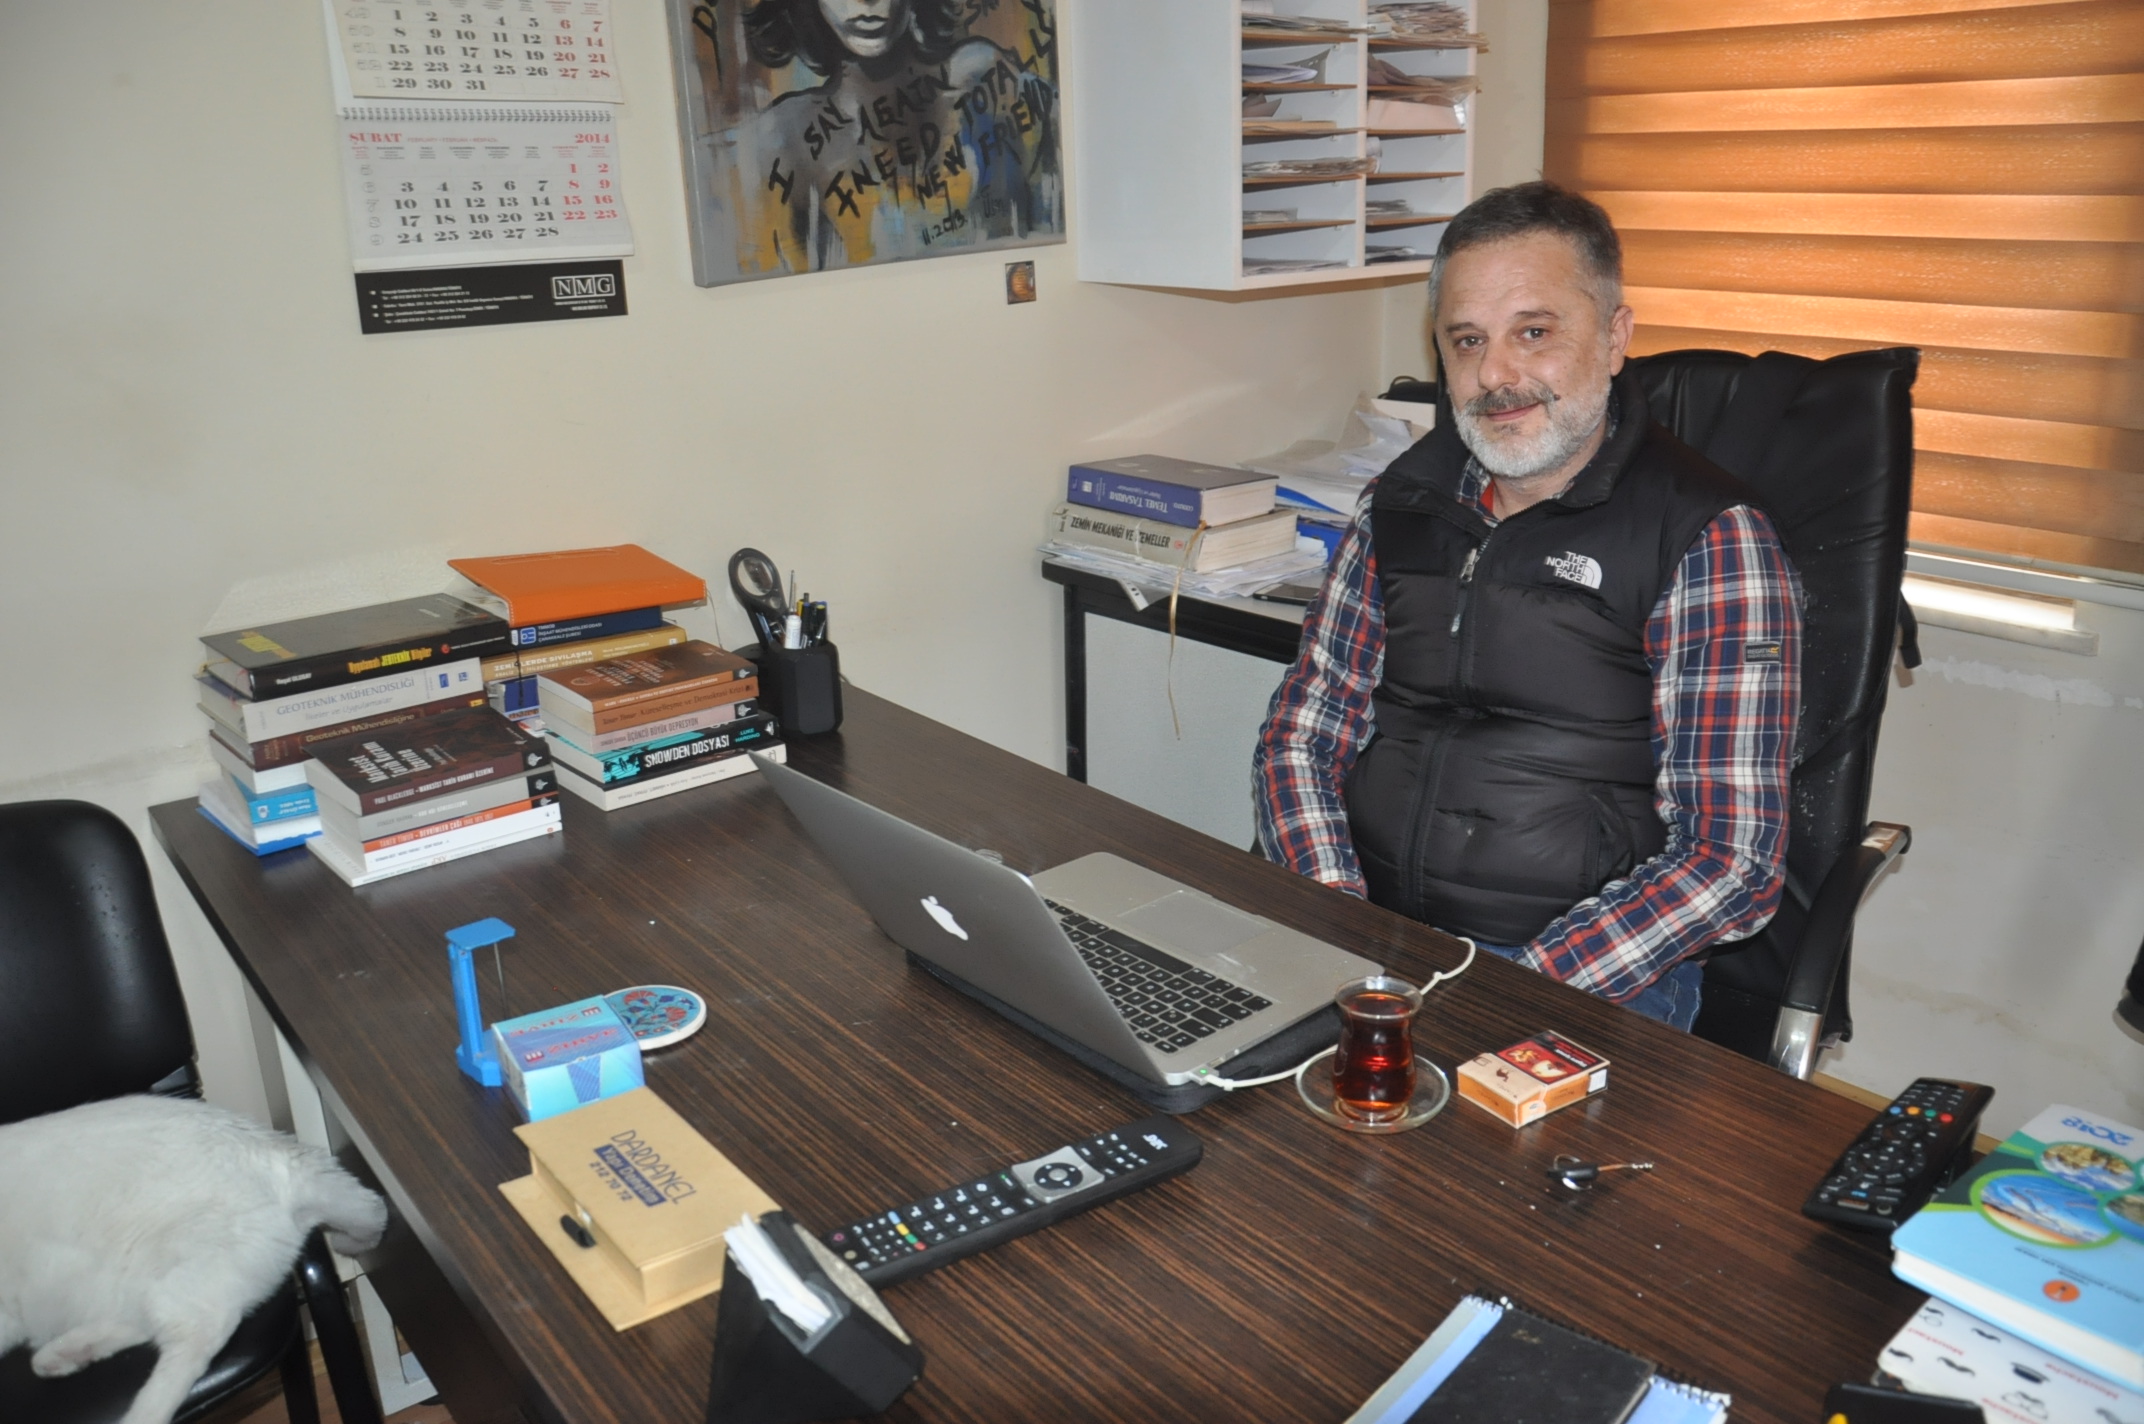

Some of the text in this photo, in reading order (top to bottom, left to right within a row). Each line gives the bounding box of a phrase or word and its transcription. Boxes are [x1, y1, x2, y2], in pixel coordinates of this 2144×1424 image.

[394, 10, 401, 20] 1
[426, 12, 438, 22] 2
[460, 14, 473, 24] 3
[494, 16, 506, 26] 4
[528, 18, 540, 28] 5
[560, 19, 572, 30] 6
[592, 20, 603, 32] 7
[394, 27, 406, 38] 8
[429, 28, 442, 38] 9
[455, 30, 476, 40] 10
[492, 32, 508, 42] 11
[522, 34, 542, 44] 12
[554, 35, 574, 46] 13
[586, 36, 604, 48] 14
[389, 44, 410, 54] 15
[424, 45, 446, 56] 16
[460, 46, 480, 58] 17
[494, 48, 513, 59] 18
[525, 50, 545, 60] 19
[554, 52, 576, 62] 20
[588, 53, 606, 64] 21
[388, 60, 414, 71] 22
[424, 62, 450, 72] 23
[460, 62, 483, 74] 24
[494, 64, 516, 75] 25
[525, 66, 549, 76] 26
[558, 68, 580, 78] 27
[588, 69, 610, 78] 28
[392, 78, 417, 88] 29
[427, 78, 452, 90] 30
[466, 80, 486, 90] 31
[574, 133, 610, 144] 2014
[570, 164, 577, 174] 1
[598, 163, 608, 173] 2
[401, 182, 414, 192] 3
[436, 182, 448, 192] 4
[472, 181, 483, 191] 5
[504, 181, 516, 190] 6
[538, 180, 548, 192] 7
[569, 180, 580, 189] 8
[600, 180, 610, 188] 9
[395, 199, 418, 210] 10
[434, 198, 451, 208] 11
[464, 198, 486, 208] 12
[498, 197, 519, 207] 13
[531, 196, 550, 206] 14
[563, 196, 582, 205] 15
[594, 195, 614, 204] 16
[400, 215, 421, 227] 17
[435, 214, 456, 224] 18
[469, 214, 490, 224] 19
[497, 213, 522, 223] 20
[534, 212, 554, 222] 21
[562, 210, 586, 220] 22
[594, 210, 617, 220] 23
[397, 232, 423, 244] 24
[434, 231, 460, 242] 25
[468, 230, 494, 240] 26
[503, 228, 526, 239] 27
[535, 227, 559, 236] 28
[556, 276, 612, 297] NMG
[1142, 499, 1169, 514] TEMEL
[1071, 515, 1091, 533] ZEMİN
[1125, 529, 1134, 540] VE
[1545, 556, 1585, 574] NORTH
[1565, 551, 1588, 566] THE
[1555, 567, 1582, 584] FACE
[494, 656, 548, 672] ZEMİLERDE
[550, 650, 593, 662] SIVILAŞMA
[276, 676, 415, 716] GEOTEKNİK MÜHENDİSLİĞİ
[650, 722, 668, 738] BÜYÜK
[668, 715, 699, 736] DEPRESYON
[645, 740, 691, 769] SNOWDEN
[692, 734, 730, 759] DOSYASI
[610, 1129, 697, 1205] DARDANEL
